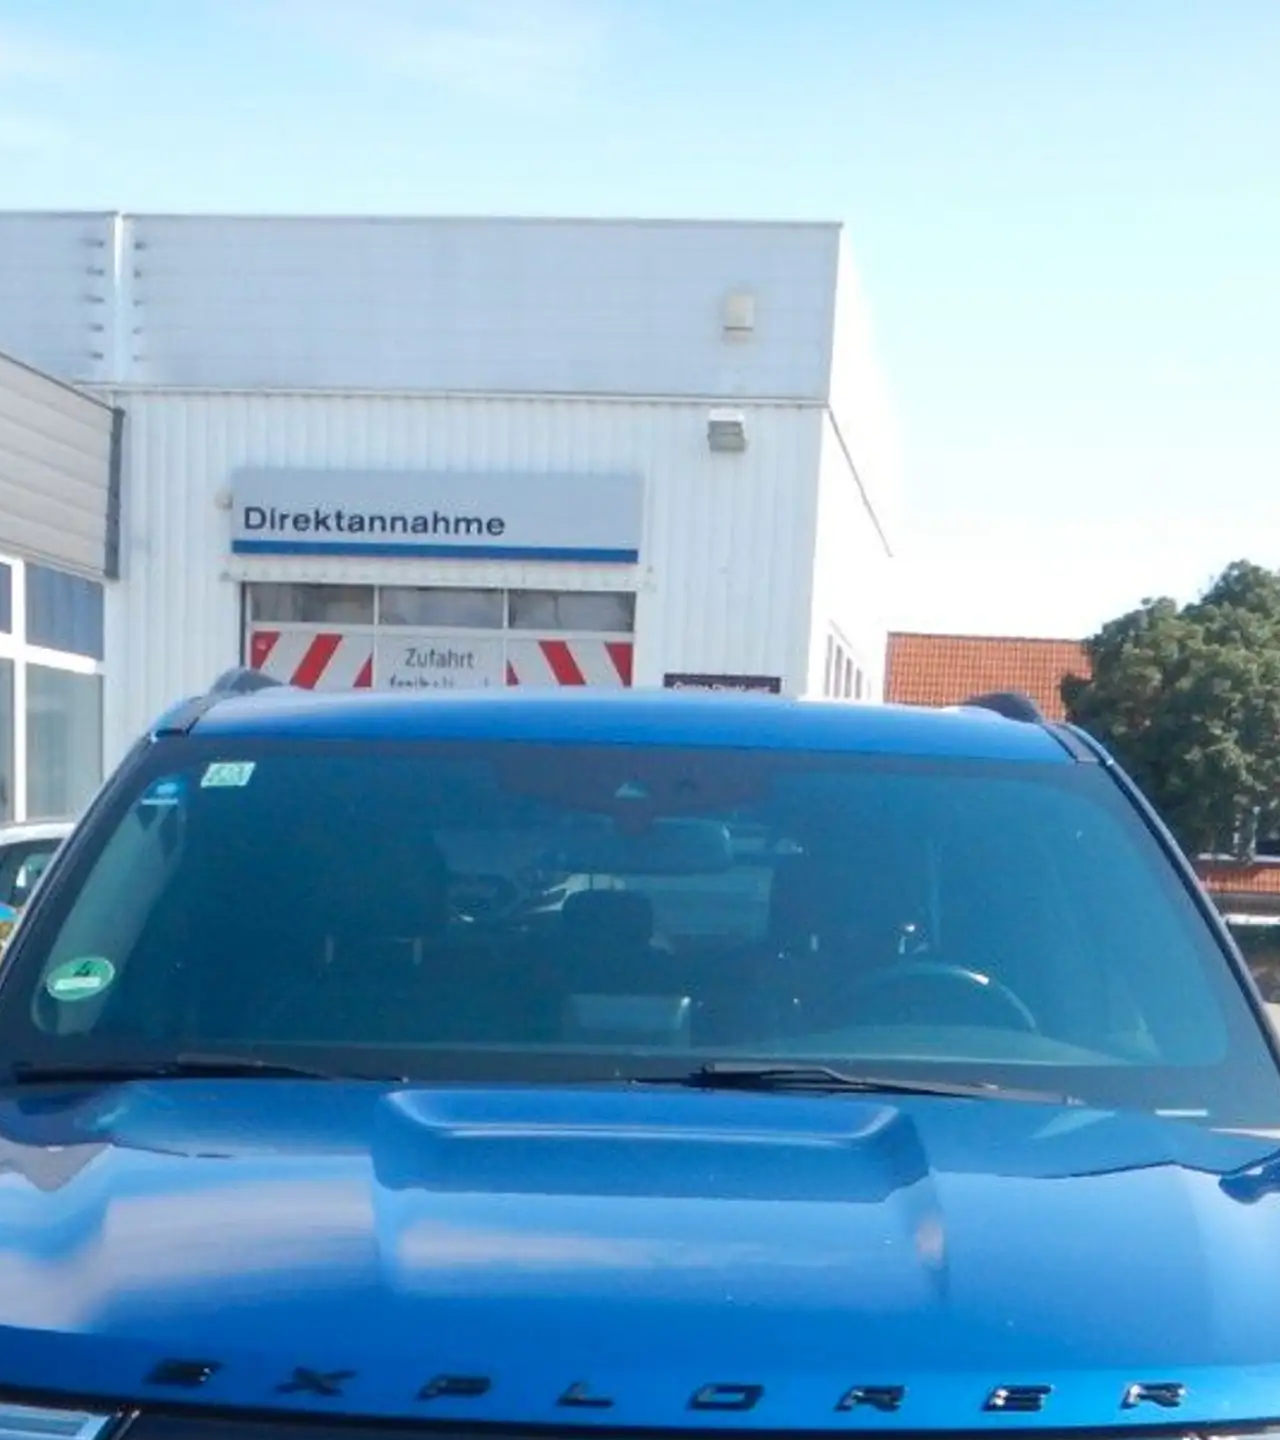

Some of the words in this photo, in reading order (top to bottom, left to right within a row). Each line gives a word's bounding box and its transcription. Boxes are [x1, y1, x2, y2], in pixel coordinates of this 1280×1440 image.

[243, 506, 506, 536] Direktannahme
[405, 648, 474, 669] Zufahrt
[142, 1359, 1186, 1412] EXPLORER
